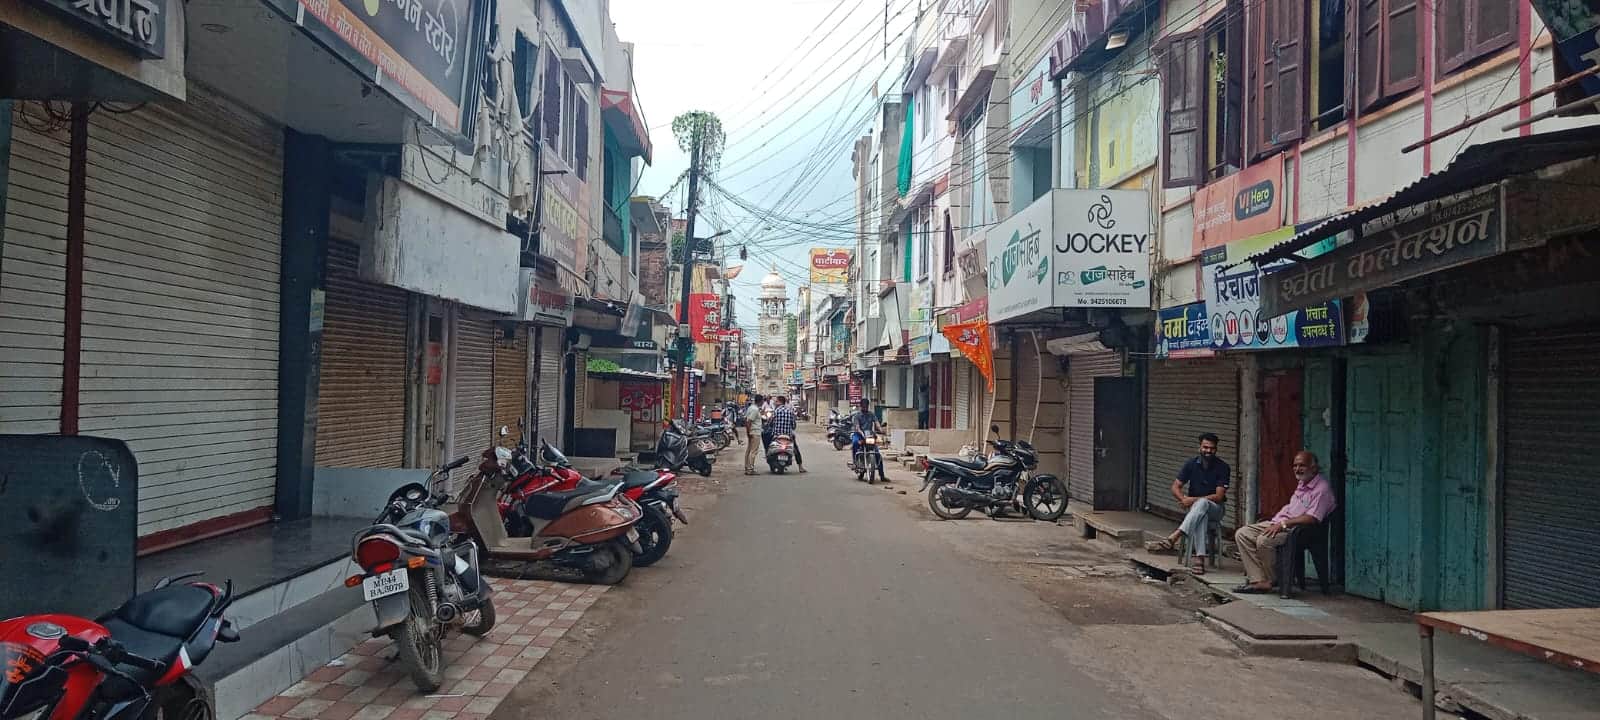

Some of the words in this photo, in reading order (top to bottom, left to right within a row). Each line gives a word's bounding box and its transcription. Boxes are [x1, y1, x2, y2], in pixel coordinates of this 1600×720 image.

[1252, 188, 1269, 206] Hero
[1056, 232, 1147, 254] JOCKEY
[1347, 208, 1494, 279] कलेक्शन
[1106, 265, 1136, 282] साहेब
[1305, 302, 1329, 321] रिचार्ज
[1164, 306, 1188, 339] वर्मा
[1328, 318, 1336, 339] है
